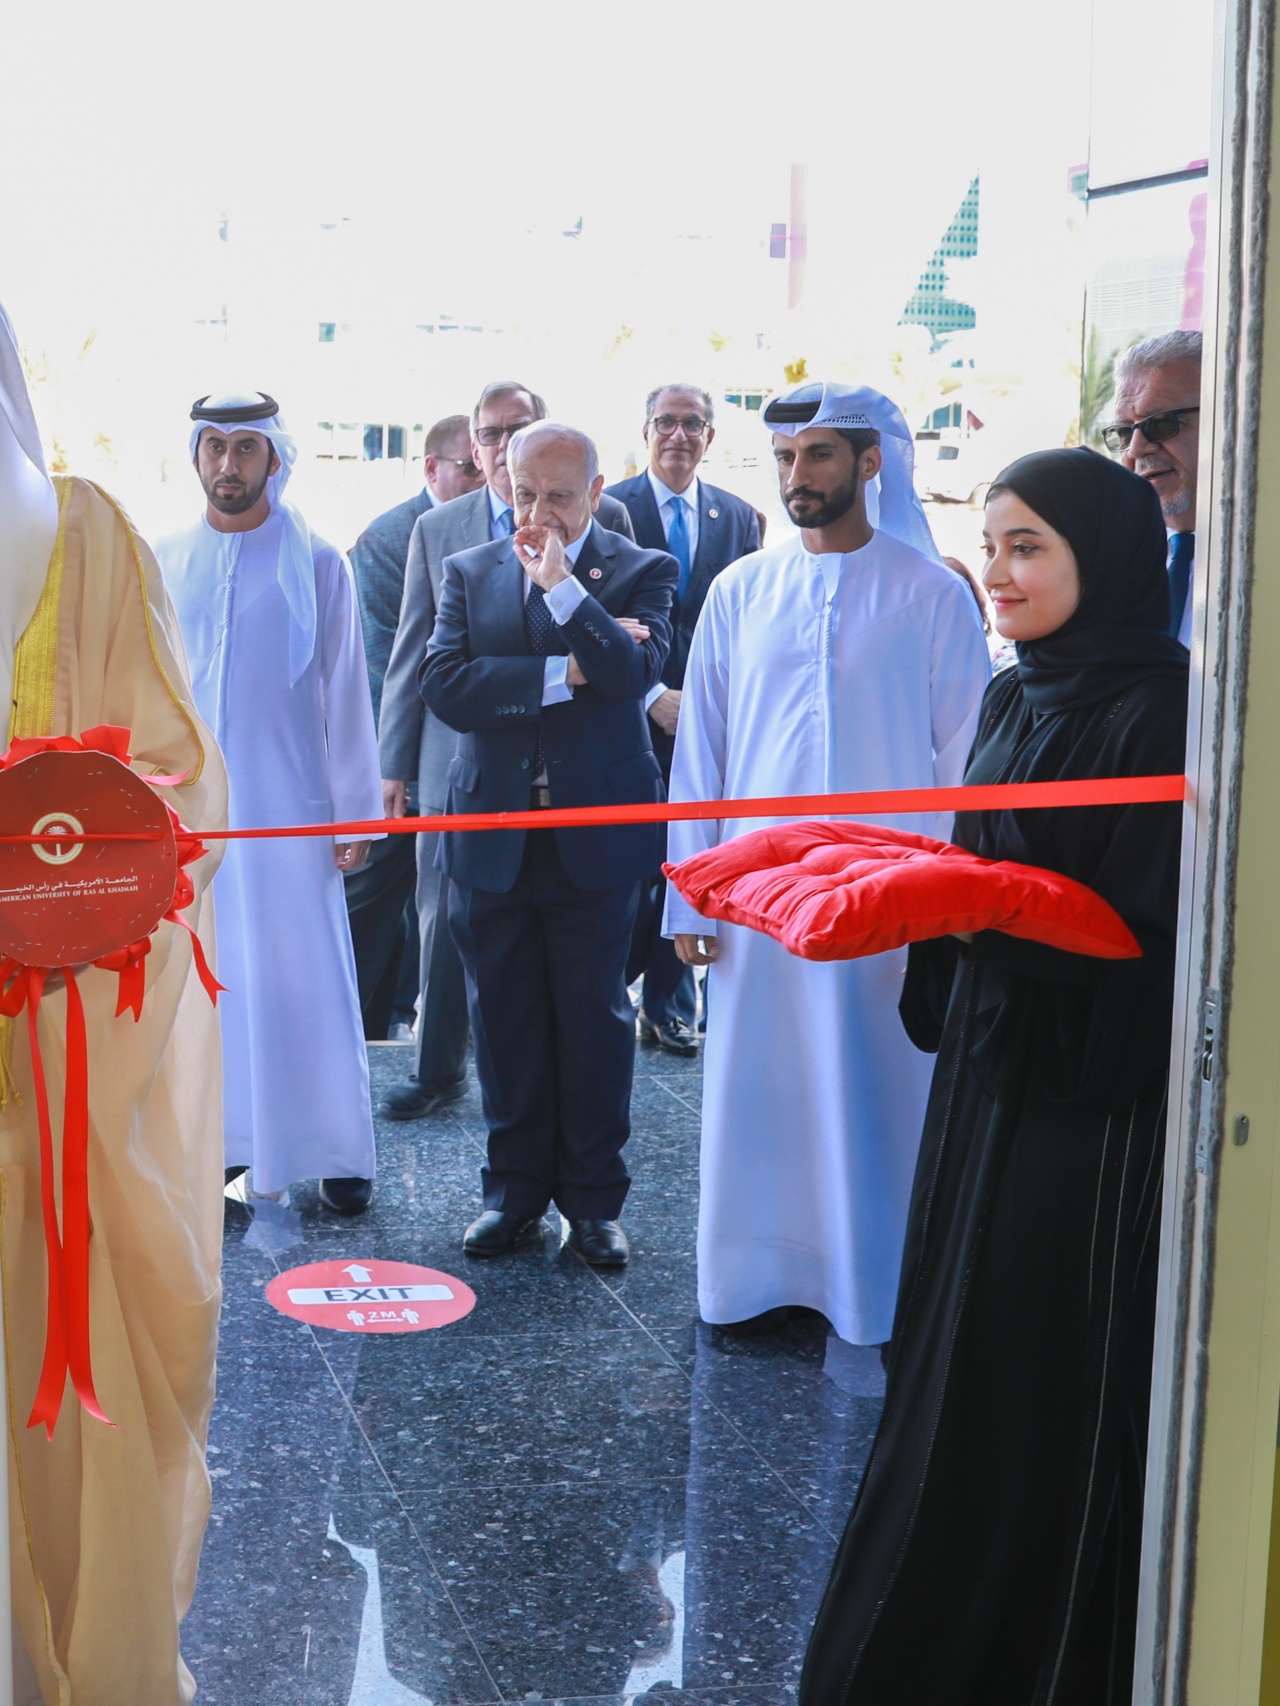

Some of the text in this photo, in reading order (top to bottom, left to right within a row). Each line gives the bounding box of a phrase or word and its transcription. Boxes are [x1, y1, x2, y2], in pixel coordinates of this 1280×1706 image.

[105, 875, 138, 884] الجامعة
[35, 882, 50, 892] رأس
[51, 882, 63, 891] في
[33, 891, 71, 900] UNIVERSITY
[107, 885, 139, 894] KHAIMAH
[323, 1287, 413, 1302] EXIT
[368, 1311, 397, 1319] 2M
